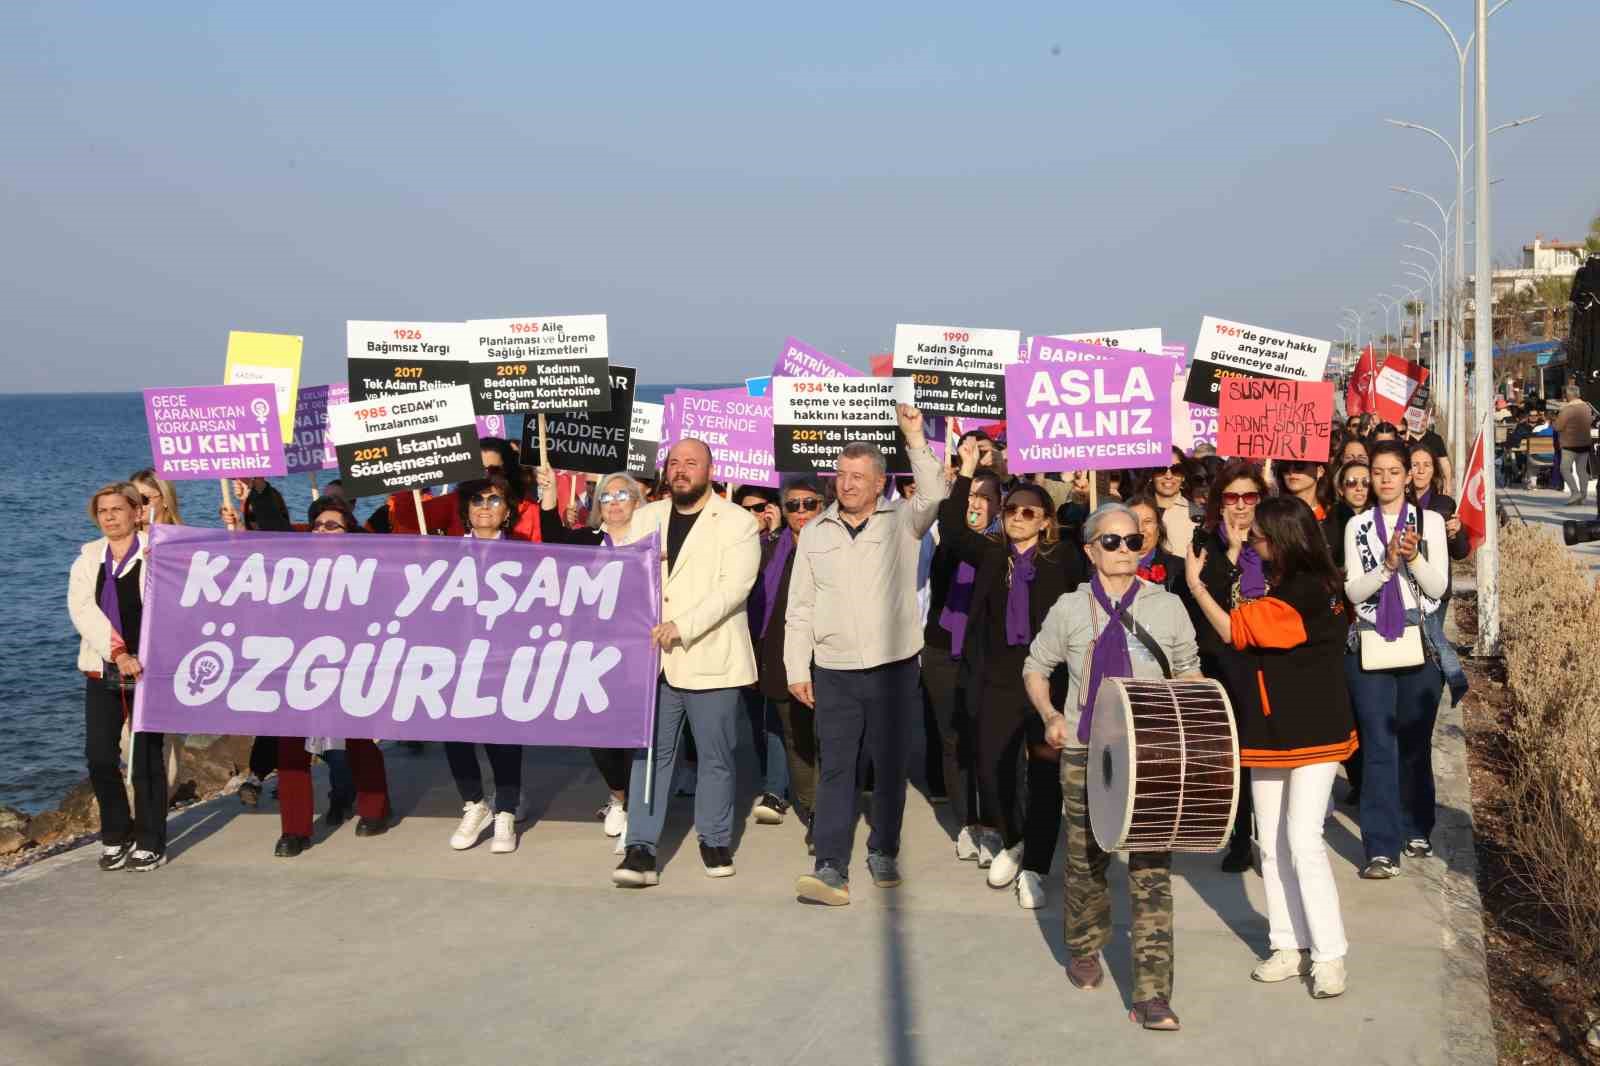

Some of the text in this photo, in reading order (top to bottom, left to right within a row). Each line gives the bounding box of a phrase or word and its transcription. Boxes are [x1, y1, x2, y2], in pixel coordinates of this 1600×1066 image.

[394, 330, 422, 340] 1926
[510, 322, 564, 334] 1965 Aile
[480, 336, 540, 346] Planlaması
[557, 332, 596, 343] Üreme
[943, 332, 969, 343] 1990
[1216, 325, 1318, 354] 1961'de grev hakkı
[367, 341, 450, 356] Bağımsız Yargı
[488, 344, 588, 359] Sağlığı Hizmetleri
[917, 343, 993, 357] Kadın Sığınma
[1039, 345, 1116, 362] BARI
[1238, 344, 1288, 361] anayasal
[496, 364, 580, 376] 2019 Kadının
[907, 355, 1002, 370] Evlerinin Açılması
[1210, 351, 1308, 377] güvenceye alındı.
[394, 367, 423, 378] 2017
[362, 378, 384, 390] Tek
[385, 380, 418, 391] Adam
[484, 375, 595, 388] Bedenine Müdahale
[793, 383, 894, 393] 1934'te kadınlar
[950, 376, 996, 389] Yetersiz
[1026, 366, 1154, 408] ASLA
[480, 386, 600, 400] ve Doğum Kontrolüne
[914, 387, 997, 402] ğınma Evleri ve
[152, 395, 187, 408] GECE
[493, 398, 588, 412] Erişim Zorlukları
[726, 400, 774, 418] SOKAK
[790, 397, 897, 409] seçme ve seçilme
[913, 401, 1003, 415] rumasız Kadınlar
[154, 406, 246, 421] KARANLIKTAN
[354, 406, 387, 421] 1985
[793, 410, 894, 420] hakkını kazandı.
[156, 420, 237, 434] KORKARSAN
[365, 414, 439, 433] İmzalanması
[682, 412, 757, 433] İŞ YERİNDE
[1027, 409, 1153, 440] YALNIZ
[545, 421, 625, 442] MADDEYE
[792, 428, 896, 441] 2021'de İstanbul
[159, 427, 270, 455] BU KENTİ
[354, 432, 462, 461] 2021 İstanbul
[531, 436, 618, 458] DOKUNMA
[286, 447, 338, 468] GÜRL
[1019, 440, 1162, 461] YÜRÜMEYECEKSİN
[163, 453, 272, 474] ATEŞE VERİRİZ
[383, 469, 444, 487] vazgeçme
[725, 465, 769, 482] DİREN
[180, 551, 624, 631] KADIN YAŞAM
[173, 620, 623, 723] ÖZGÜRLÜK
